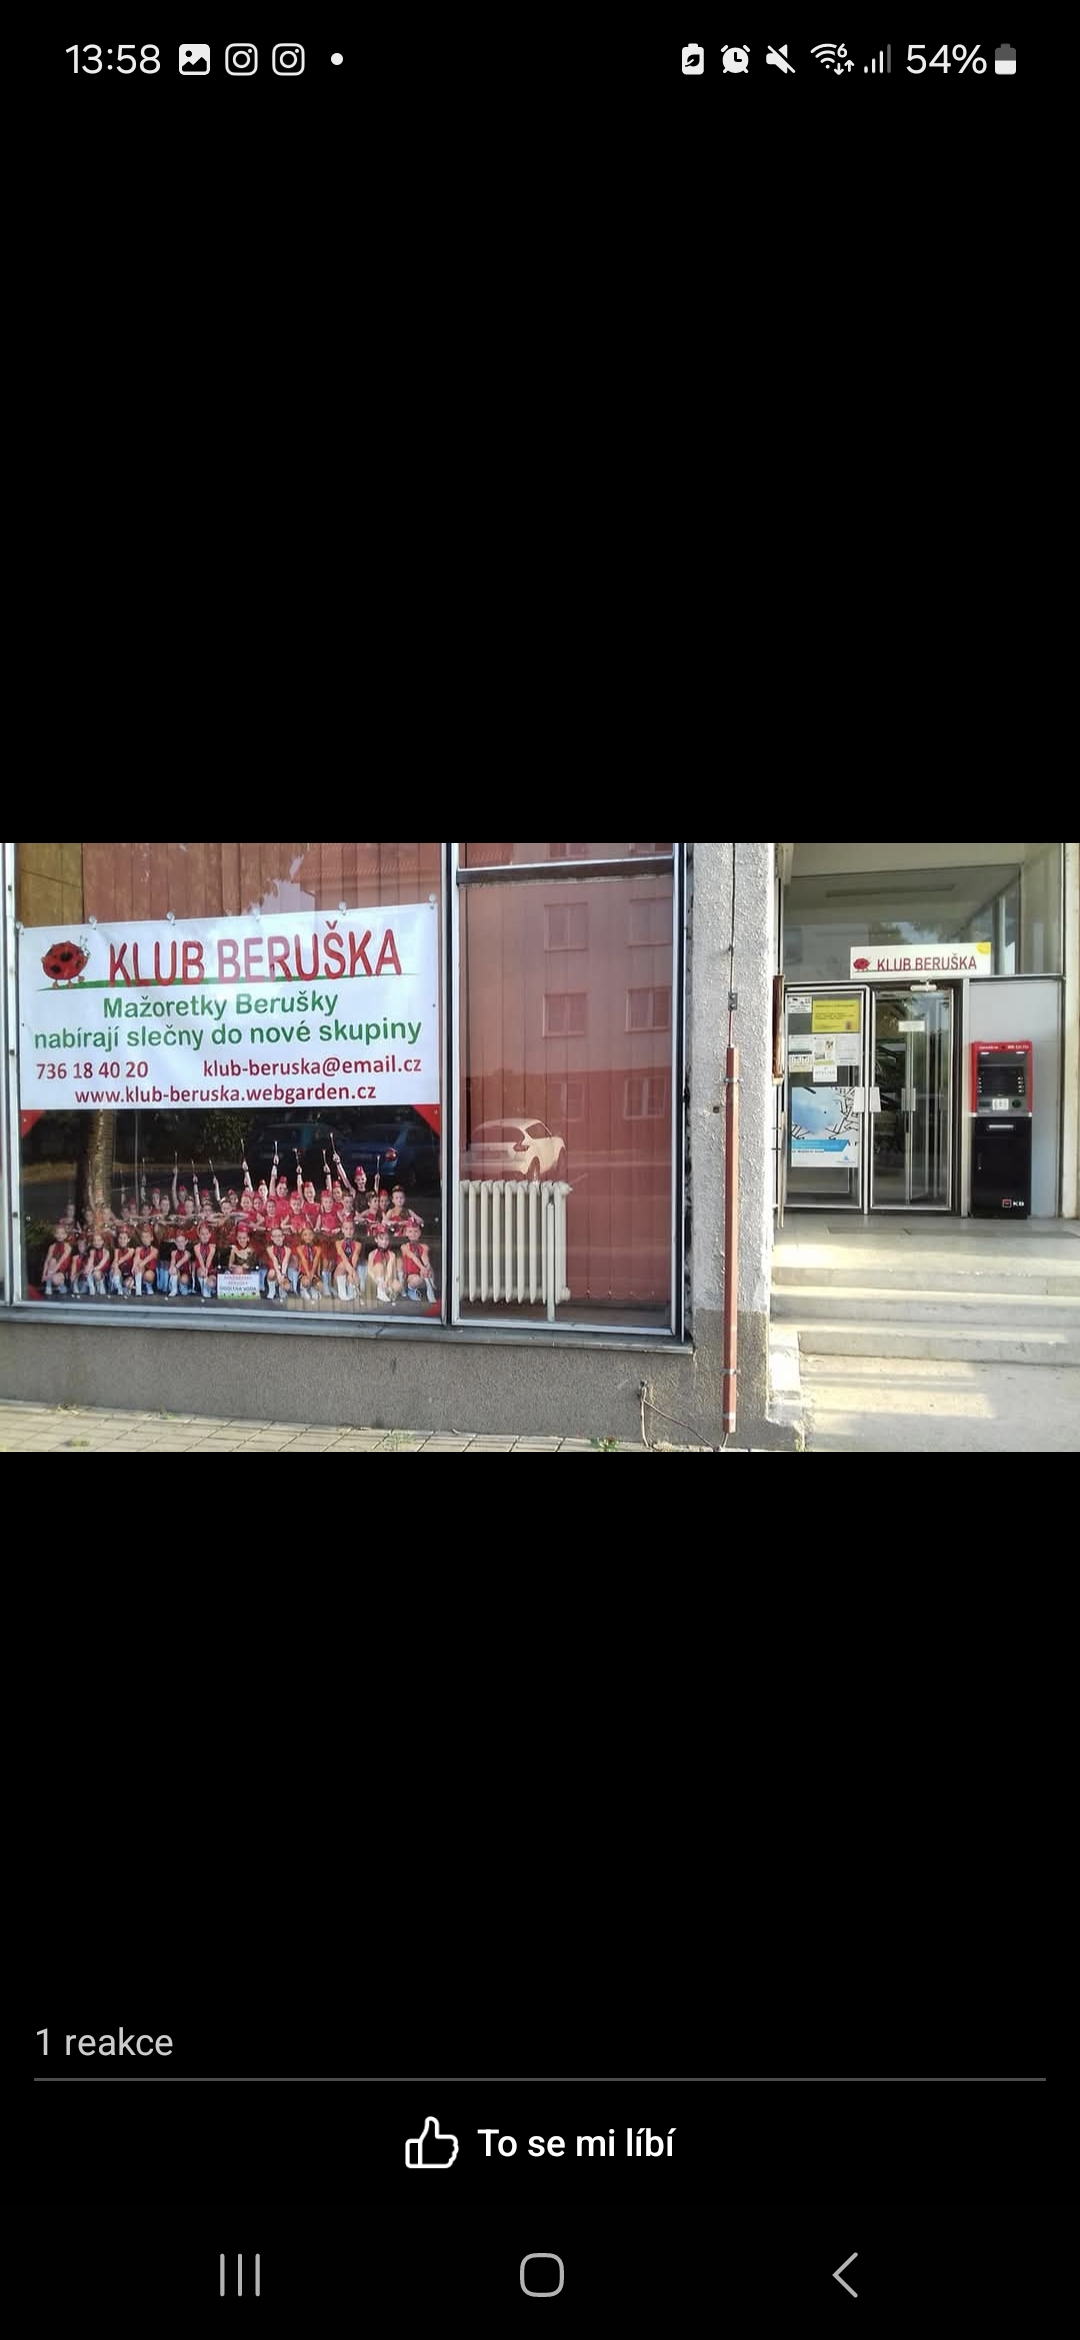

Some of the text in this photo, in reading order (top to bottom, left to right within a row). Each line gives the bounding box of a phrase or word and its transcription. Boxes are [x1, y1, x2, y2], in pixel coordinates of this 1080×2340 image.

[109, 920, 402, 988] KLUB BERUŠKA
[877, 952, 977, 972] KLUB BERUŠKA
[103, 990, 339, 1021] Mažoretky Berušky
[34, 1017, 422, 1053] nabírají slečny do nové skupiny
[36, 1061, 149, 1080] 736 18 40 20
[203, 1055, 423, 1077] klub-beruska@email.cz
[75, 1083, 377, 1104] www.klub-beruska.webgarden.cz
